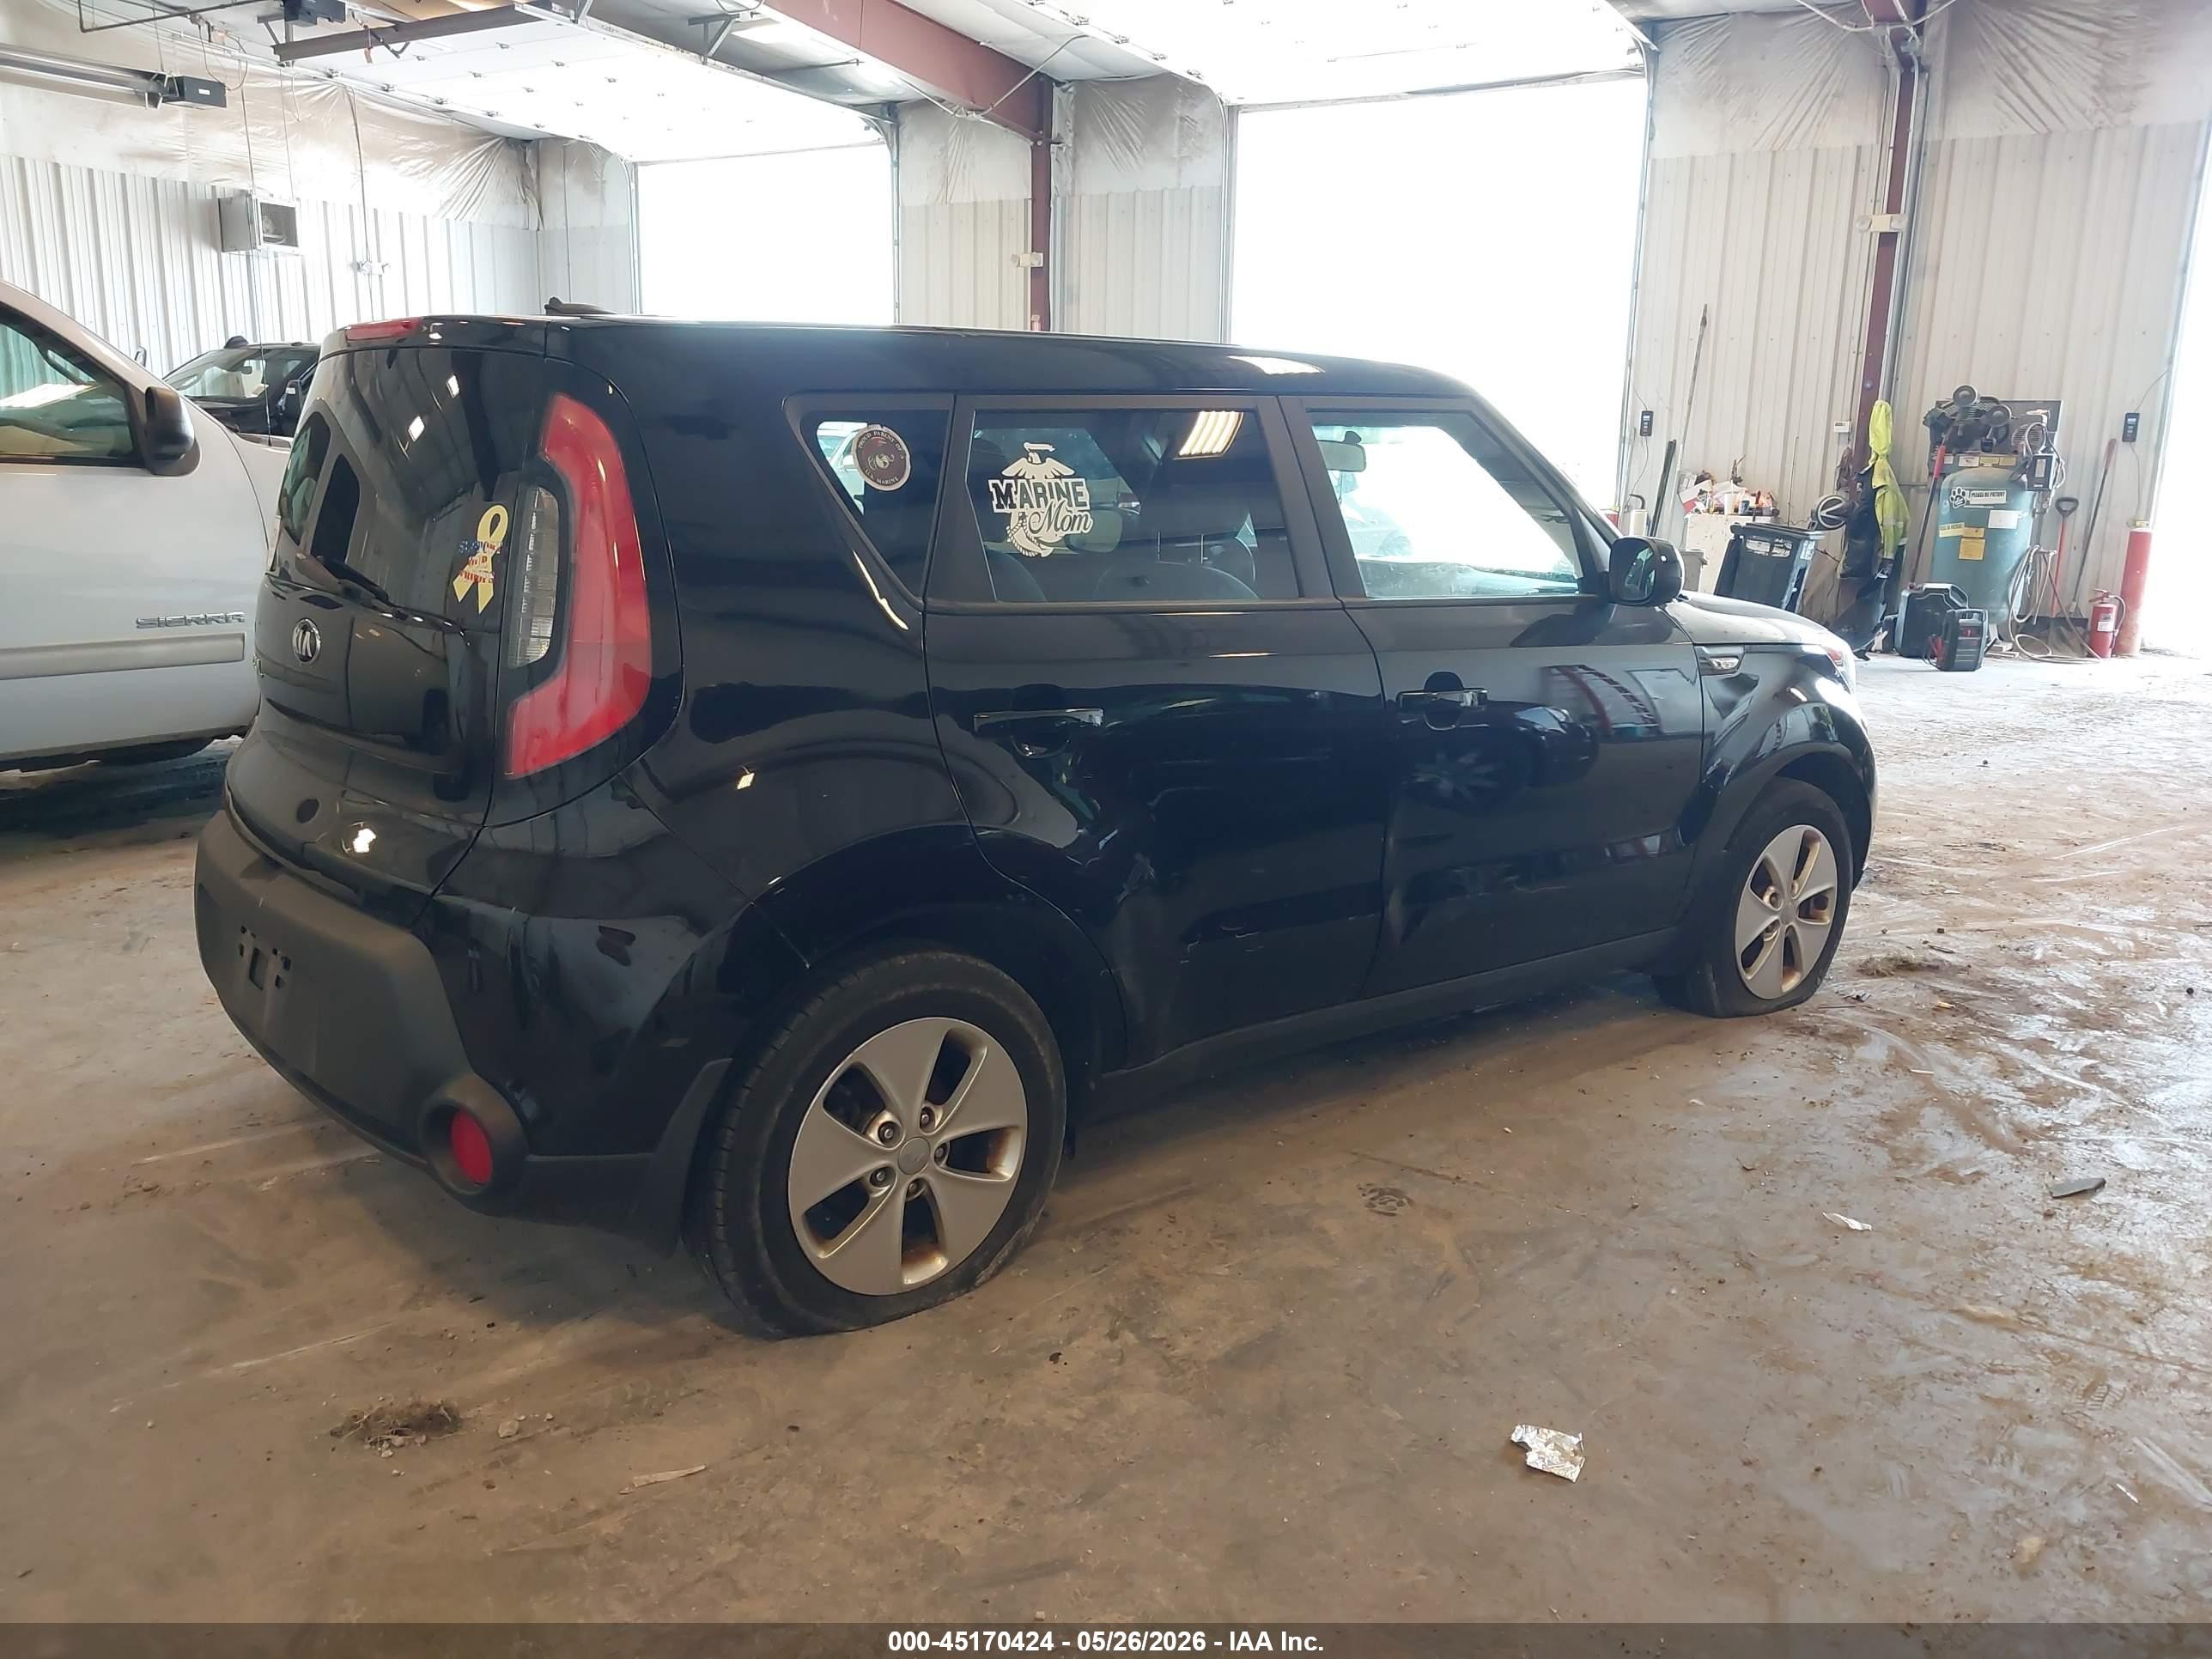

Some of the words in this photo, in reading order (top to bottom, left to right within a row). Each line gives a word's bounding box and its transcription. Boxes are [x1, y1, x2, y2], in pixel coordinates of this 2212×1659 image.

[873, 431, 896, 443] PARENT
[992, 480, 1088, 510] MARINE
[1030, 500, 1091, 534] Mom
[136, 611, 245, 629] SIERRA
